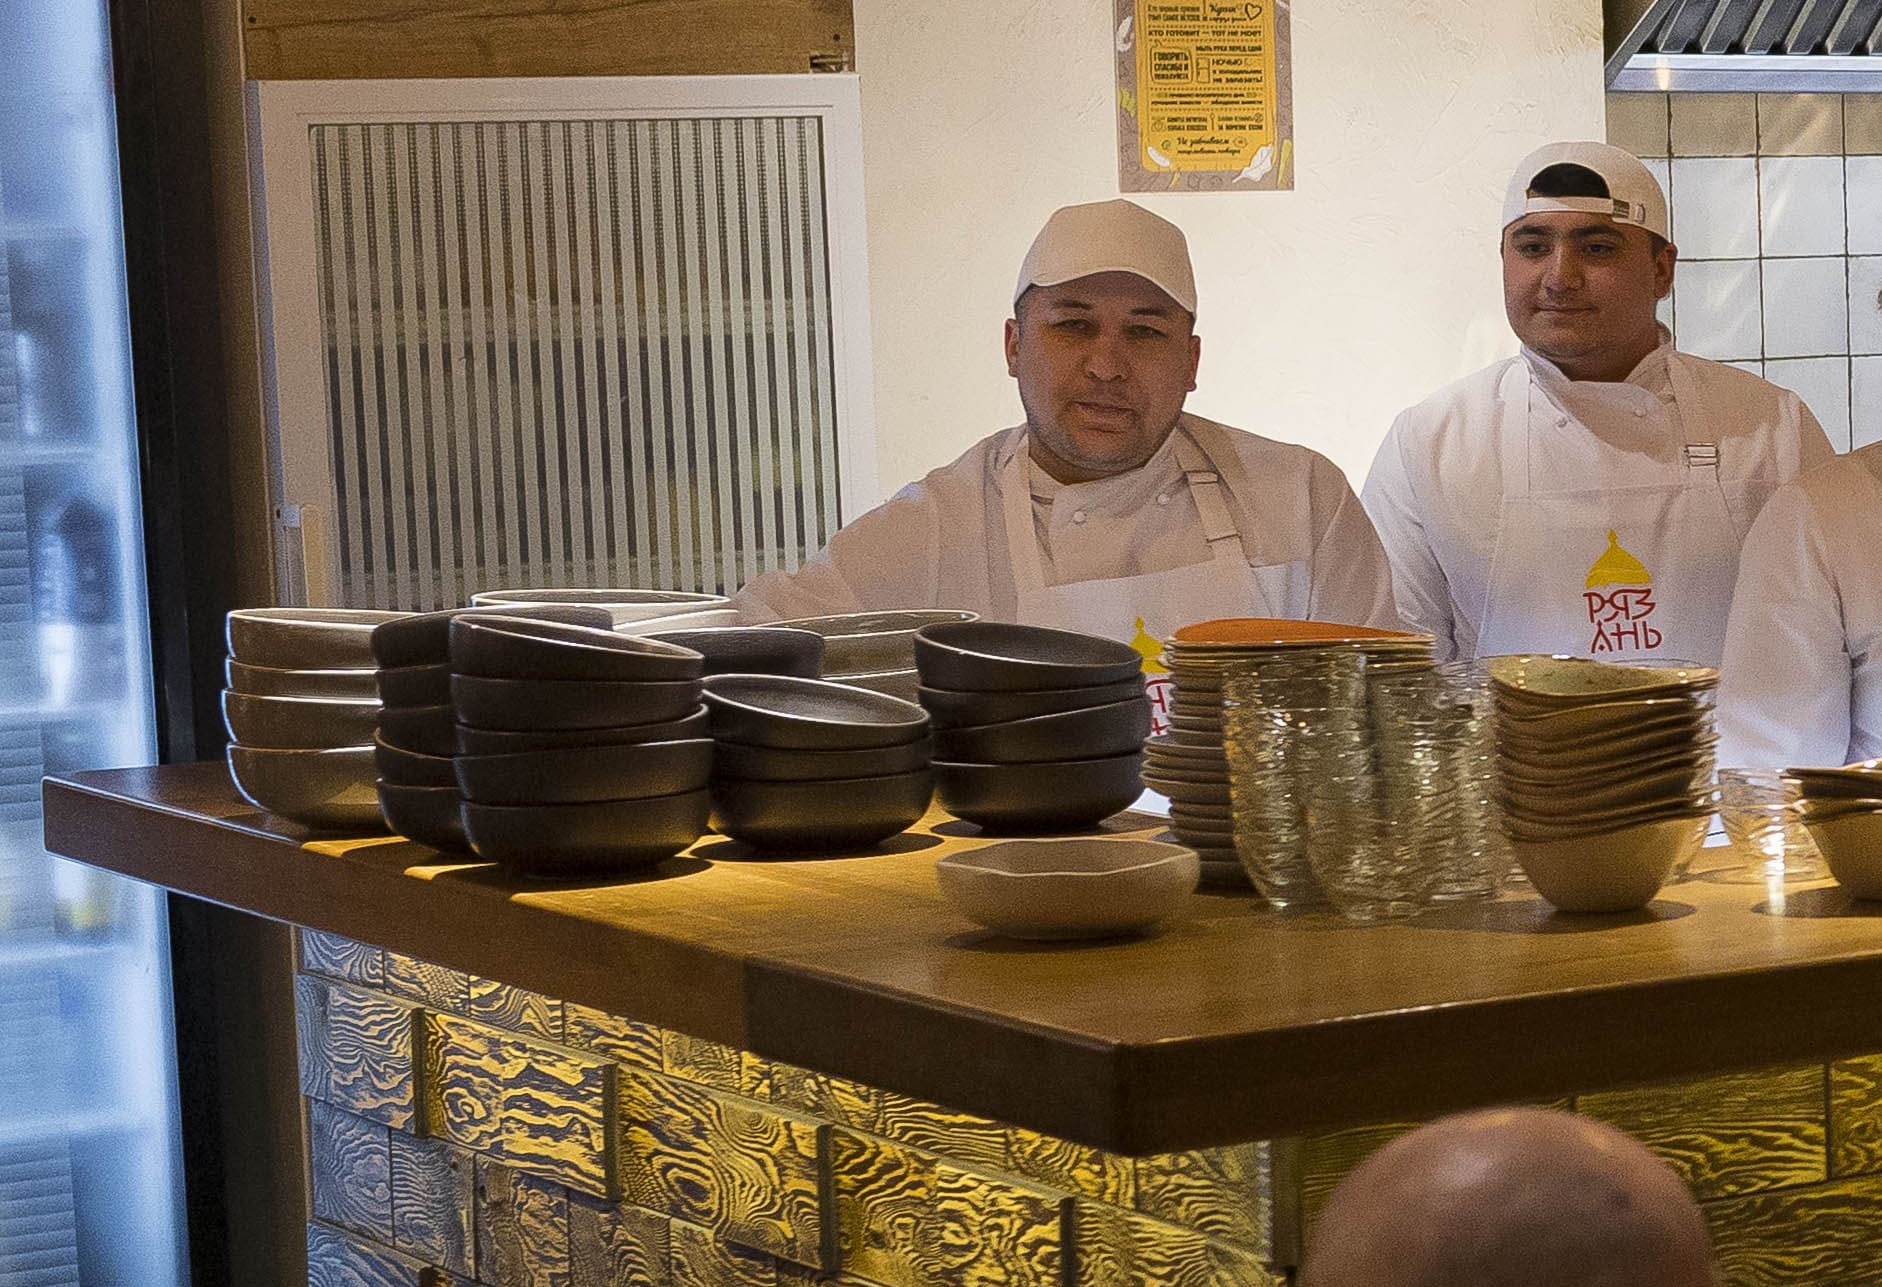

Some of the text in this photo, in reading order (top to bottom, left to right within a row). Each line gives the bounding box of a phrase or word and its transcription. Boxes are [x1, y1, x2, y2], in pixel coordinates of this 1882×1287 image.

[1153, 52, 1189, 61] ГОВОРИТЬ
[1154, 63, 1183, 71] СПАСИБО
[1582, 588, 1657, 624] РЯЗ
[1591, 619, 1663, 654] АНЬ
